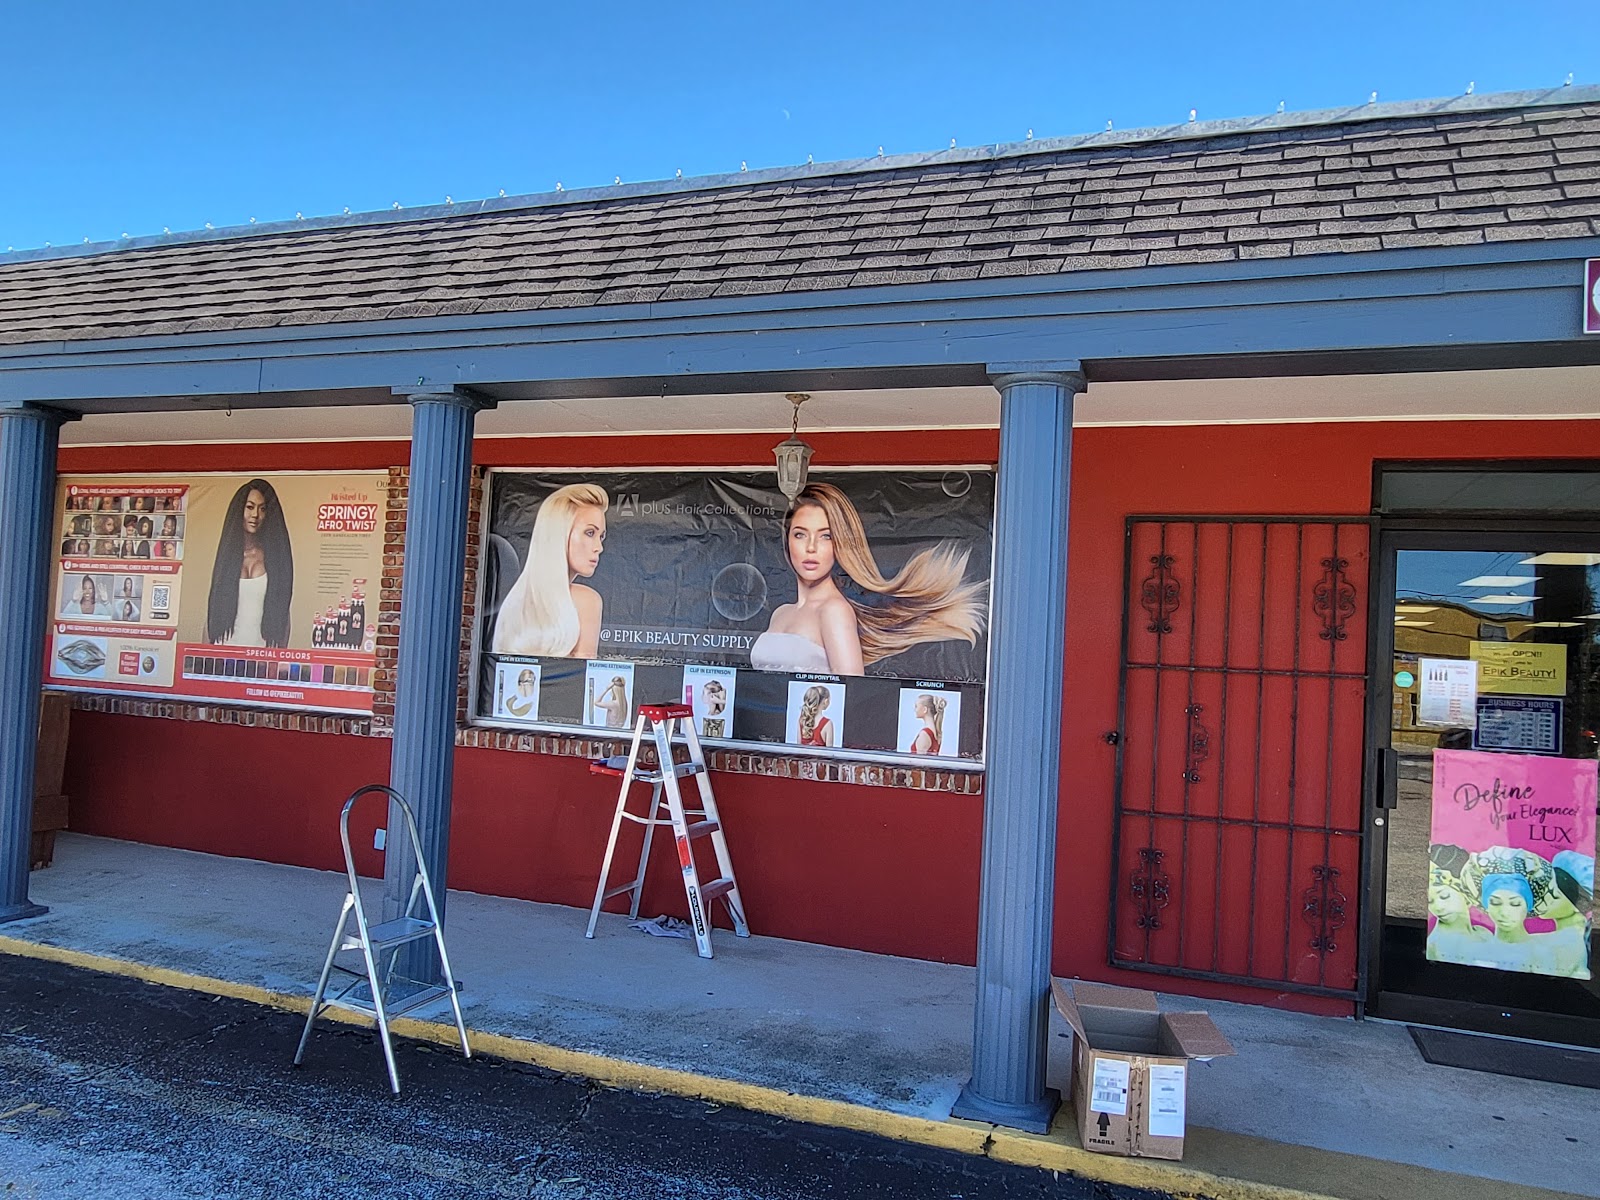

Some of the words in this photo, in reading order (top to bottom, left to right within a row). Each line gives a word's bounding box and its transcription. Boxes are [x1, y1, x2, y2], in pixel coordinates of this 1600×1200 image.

[319, 505, 377, 520] SPRINGY
[676, 503, 701, 515] Hair
[704, 502, 776, 516] Collections
[318, 520, 344, 530] AFRO
[345, 520, 376, 531] TWIST
[614, 630, 643, 643] EPIK
[646, 632, 700, 646] BEAUTY
[702, 634, 753, 649] SUPPLY
[246, 649, 276, 658] SPECIAL
[280, 651, 311, 660] COLORS
[915, 680, 945, 688] SCRUNCH
[1488, 699, 1526, 708] BUSINESS
[1528, 701, 1555, 709] HOURS
[1454, 778, 1536, 816] Define
[1529, 824, 1573, 844] LUX
[691, 894, 704, 936] LOUISVILLE
[1089, 1137, 1116, 1146] FRAGILE
